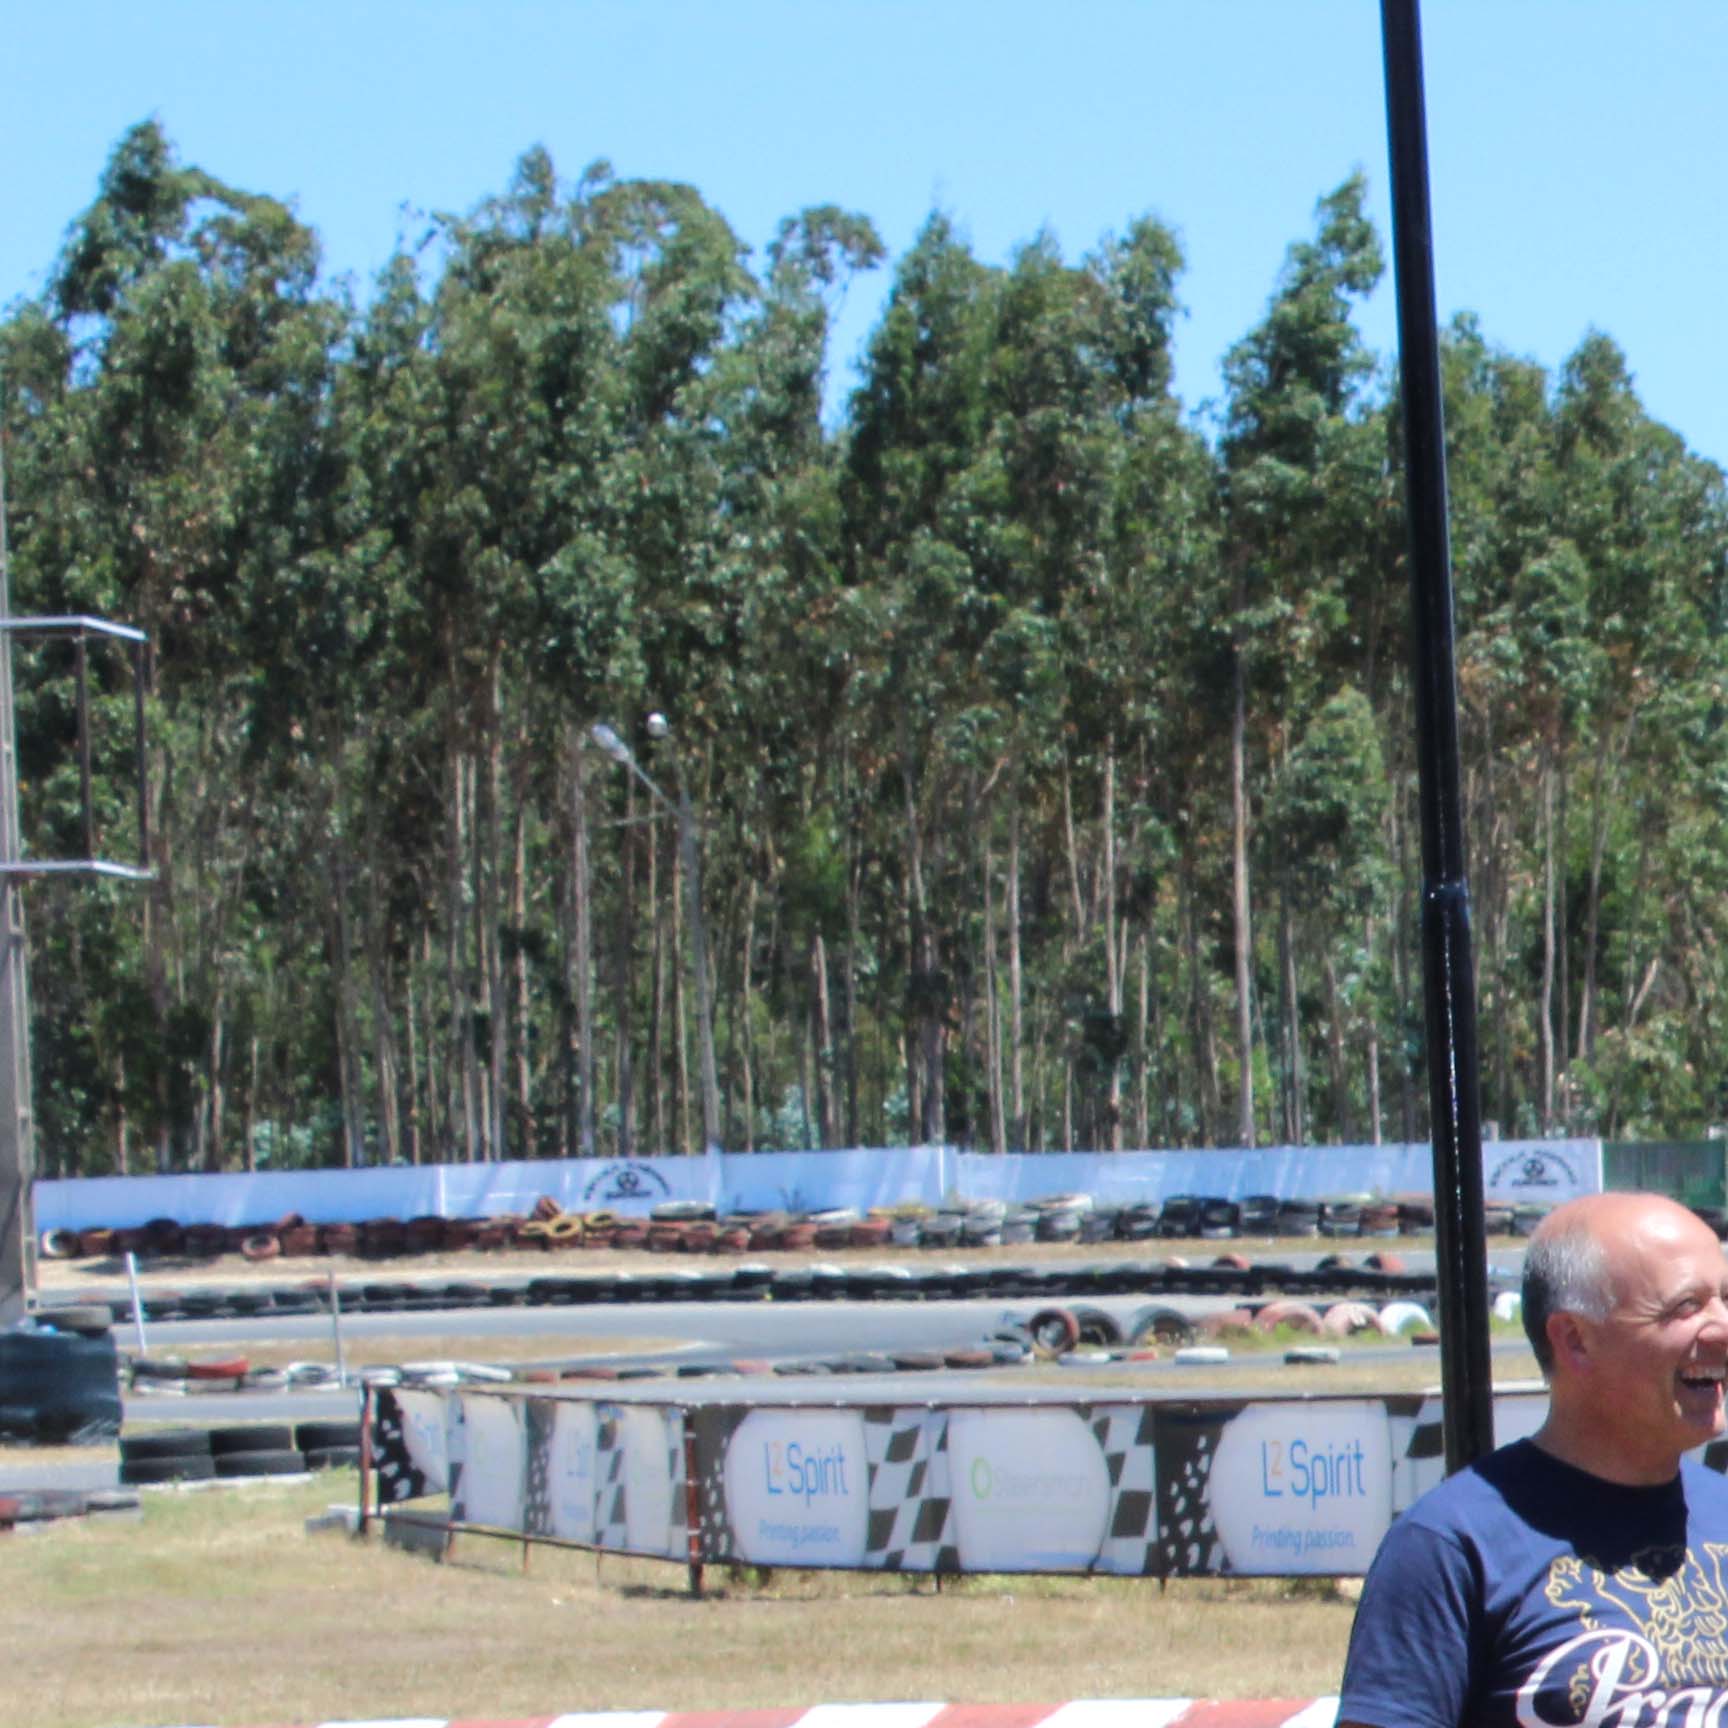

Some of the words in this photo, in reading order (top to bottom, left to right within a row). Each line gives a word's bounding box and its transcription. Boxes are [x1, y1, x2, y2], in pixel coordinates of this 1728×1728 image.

[786, 1440, 848, 1508] Spirit
[1289, 1437, 1367, 1511] Spirit
[1250, 1523, 1302, 1557] Printing
